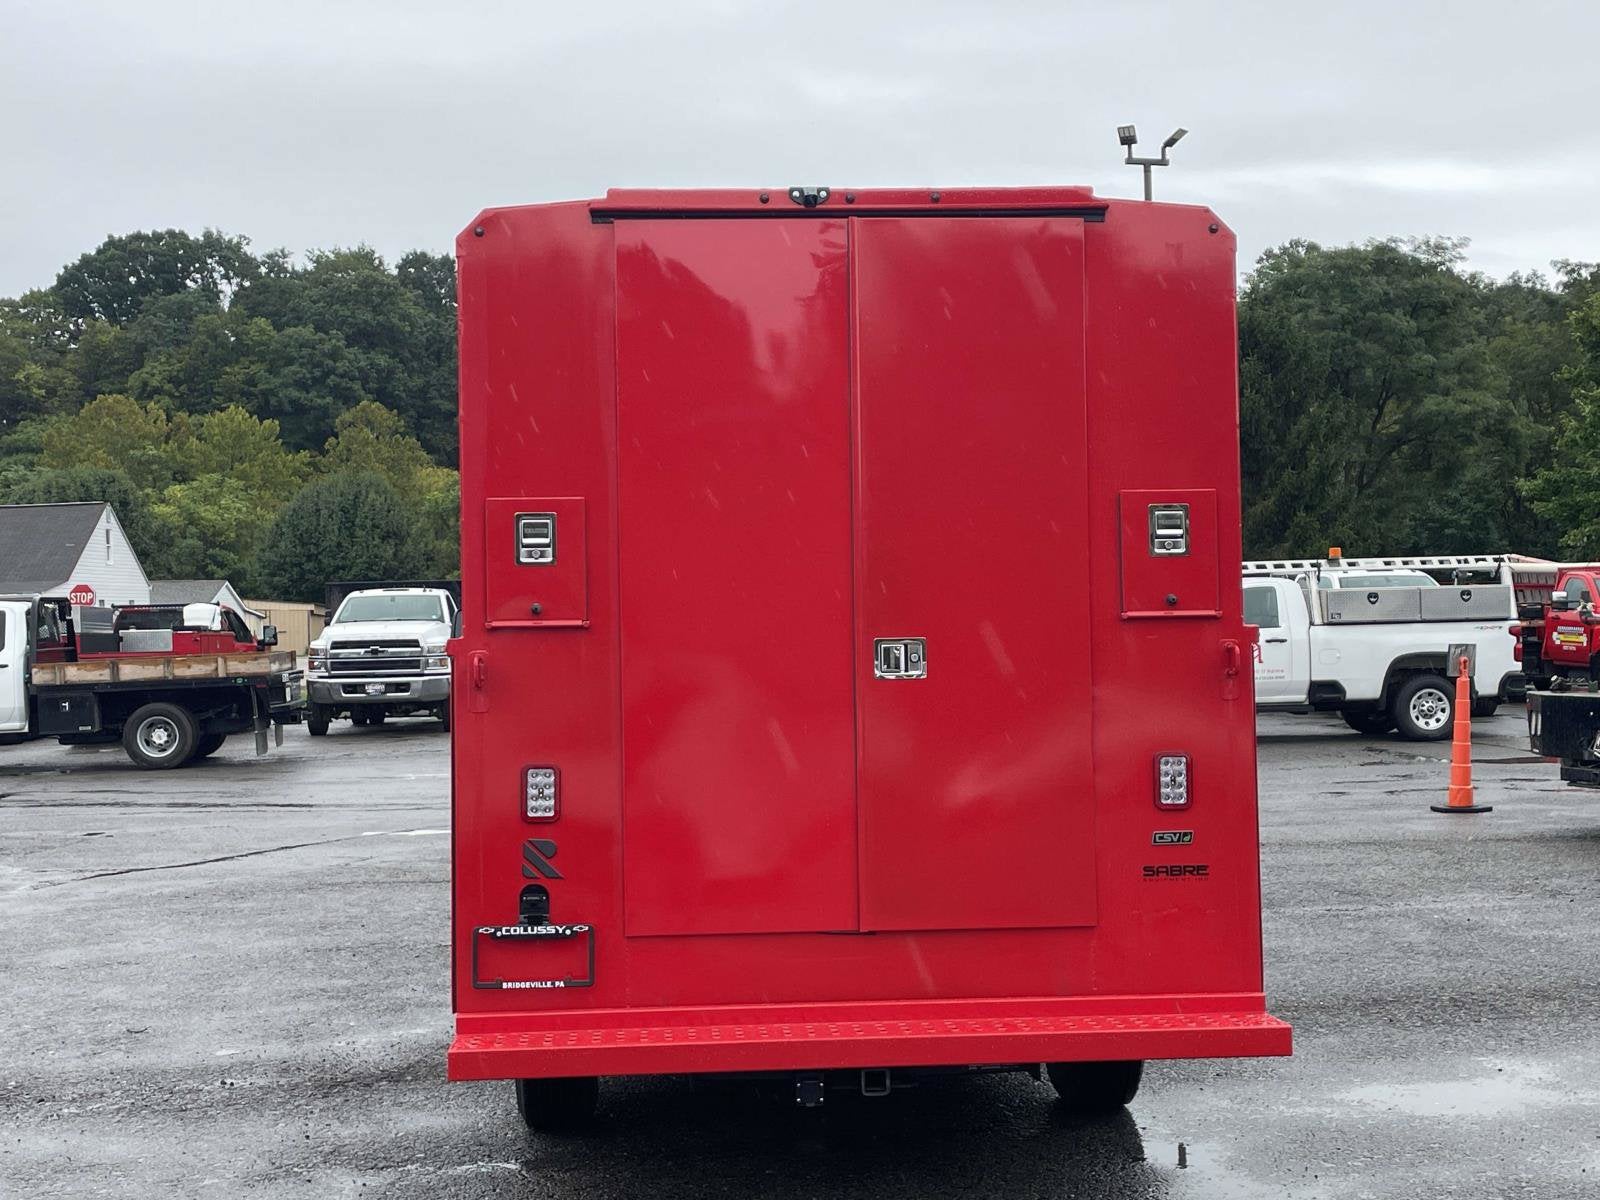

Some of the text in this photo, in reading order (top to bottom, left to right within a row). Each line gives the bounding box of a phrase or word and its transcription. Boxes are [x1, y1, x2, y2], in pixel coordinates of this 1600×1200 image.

[71, 592, 94, 603] STOP
[1156, 833, 1179, 842] CSV
[1143, 865, 1209, 876] SABRE
[502, 925, 566, 935] COLUSSY
[554, 980, 565, 988] PA
